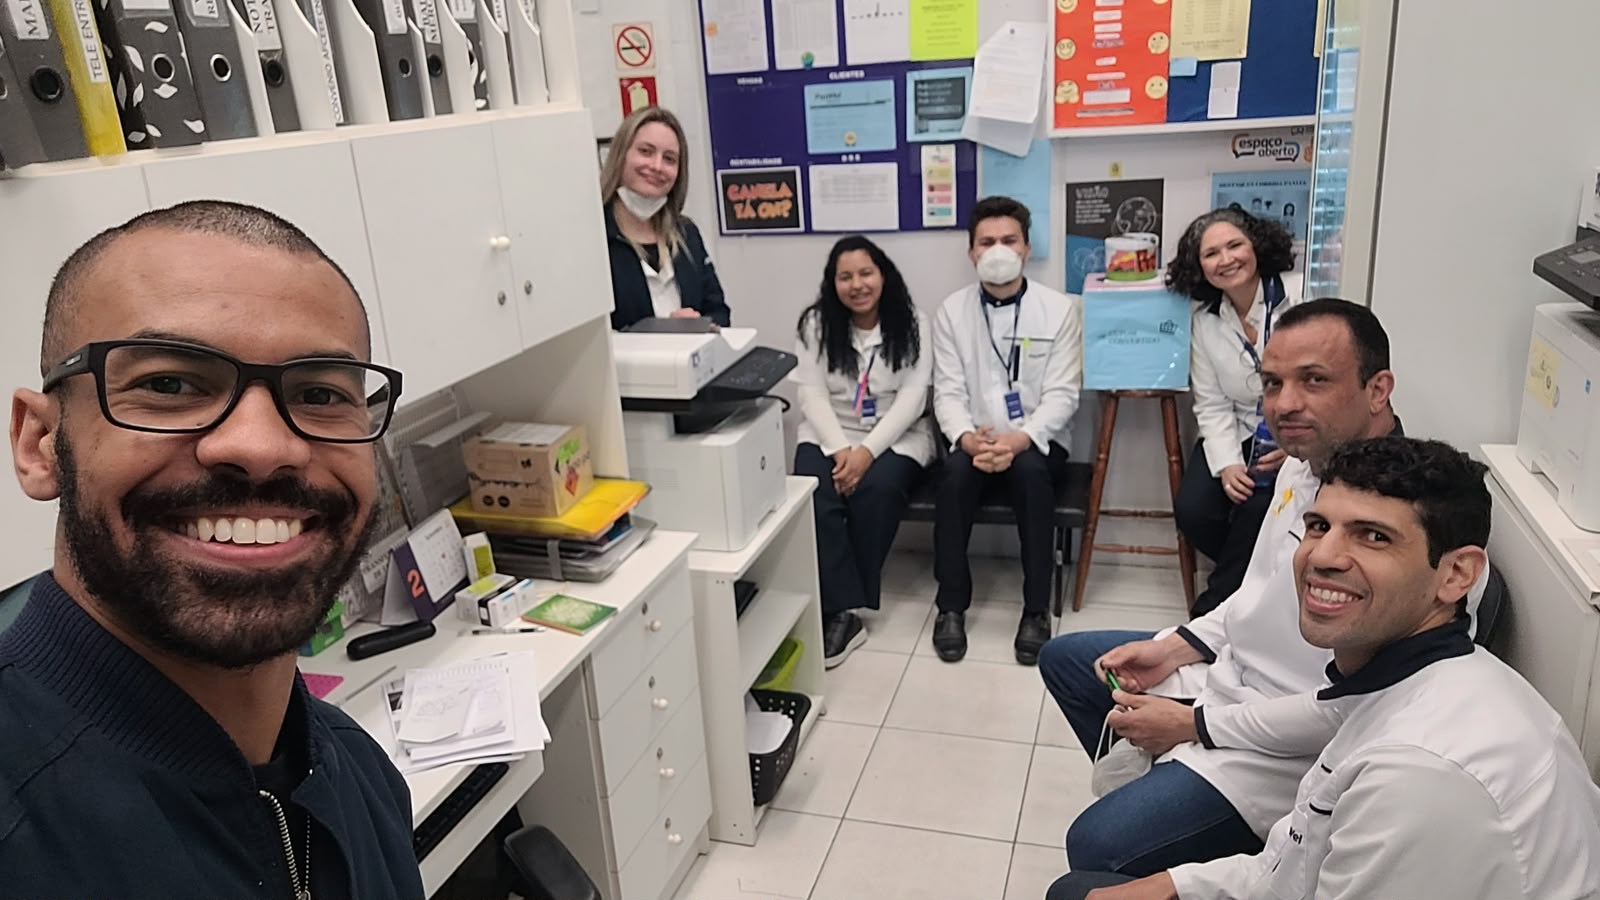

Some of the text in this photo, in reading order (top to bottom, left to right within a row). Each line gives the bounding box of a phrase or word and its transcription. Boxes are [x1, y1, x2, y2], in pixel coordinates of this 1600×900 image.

[86, 45, 103, 78] TELE
[1239, 137, 1282, 150] espaço
[1258, 146, 1295, 158] aberto
[727, 182, 793, 202] CANELA
